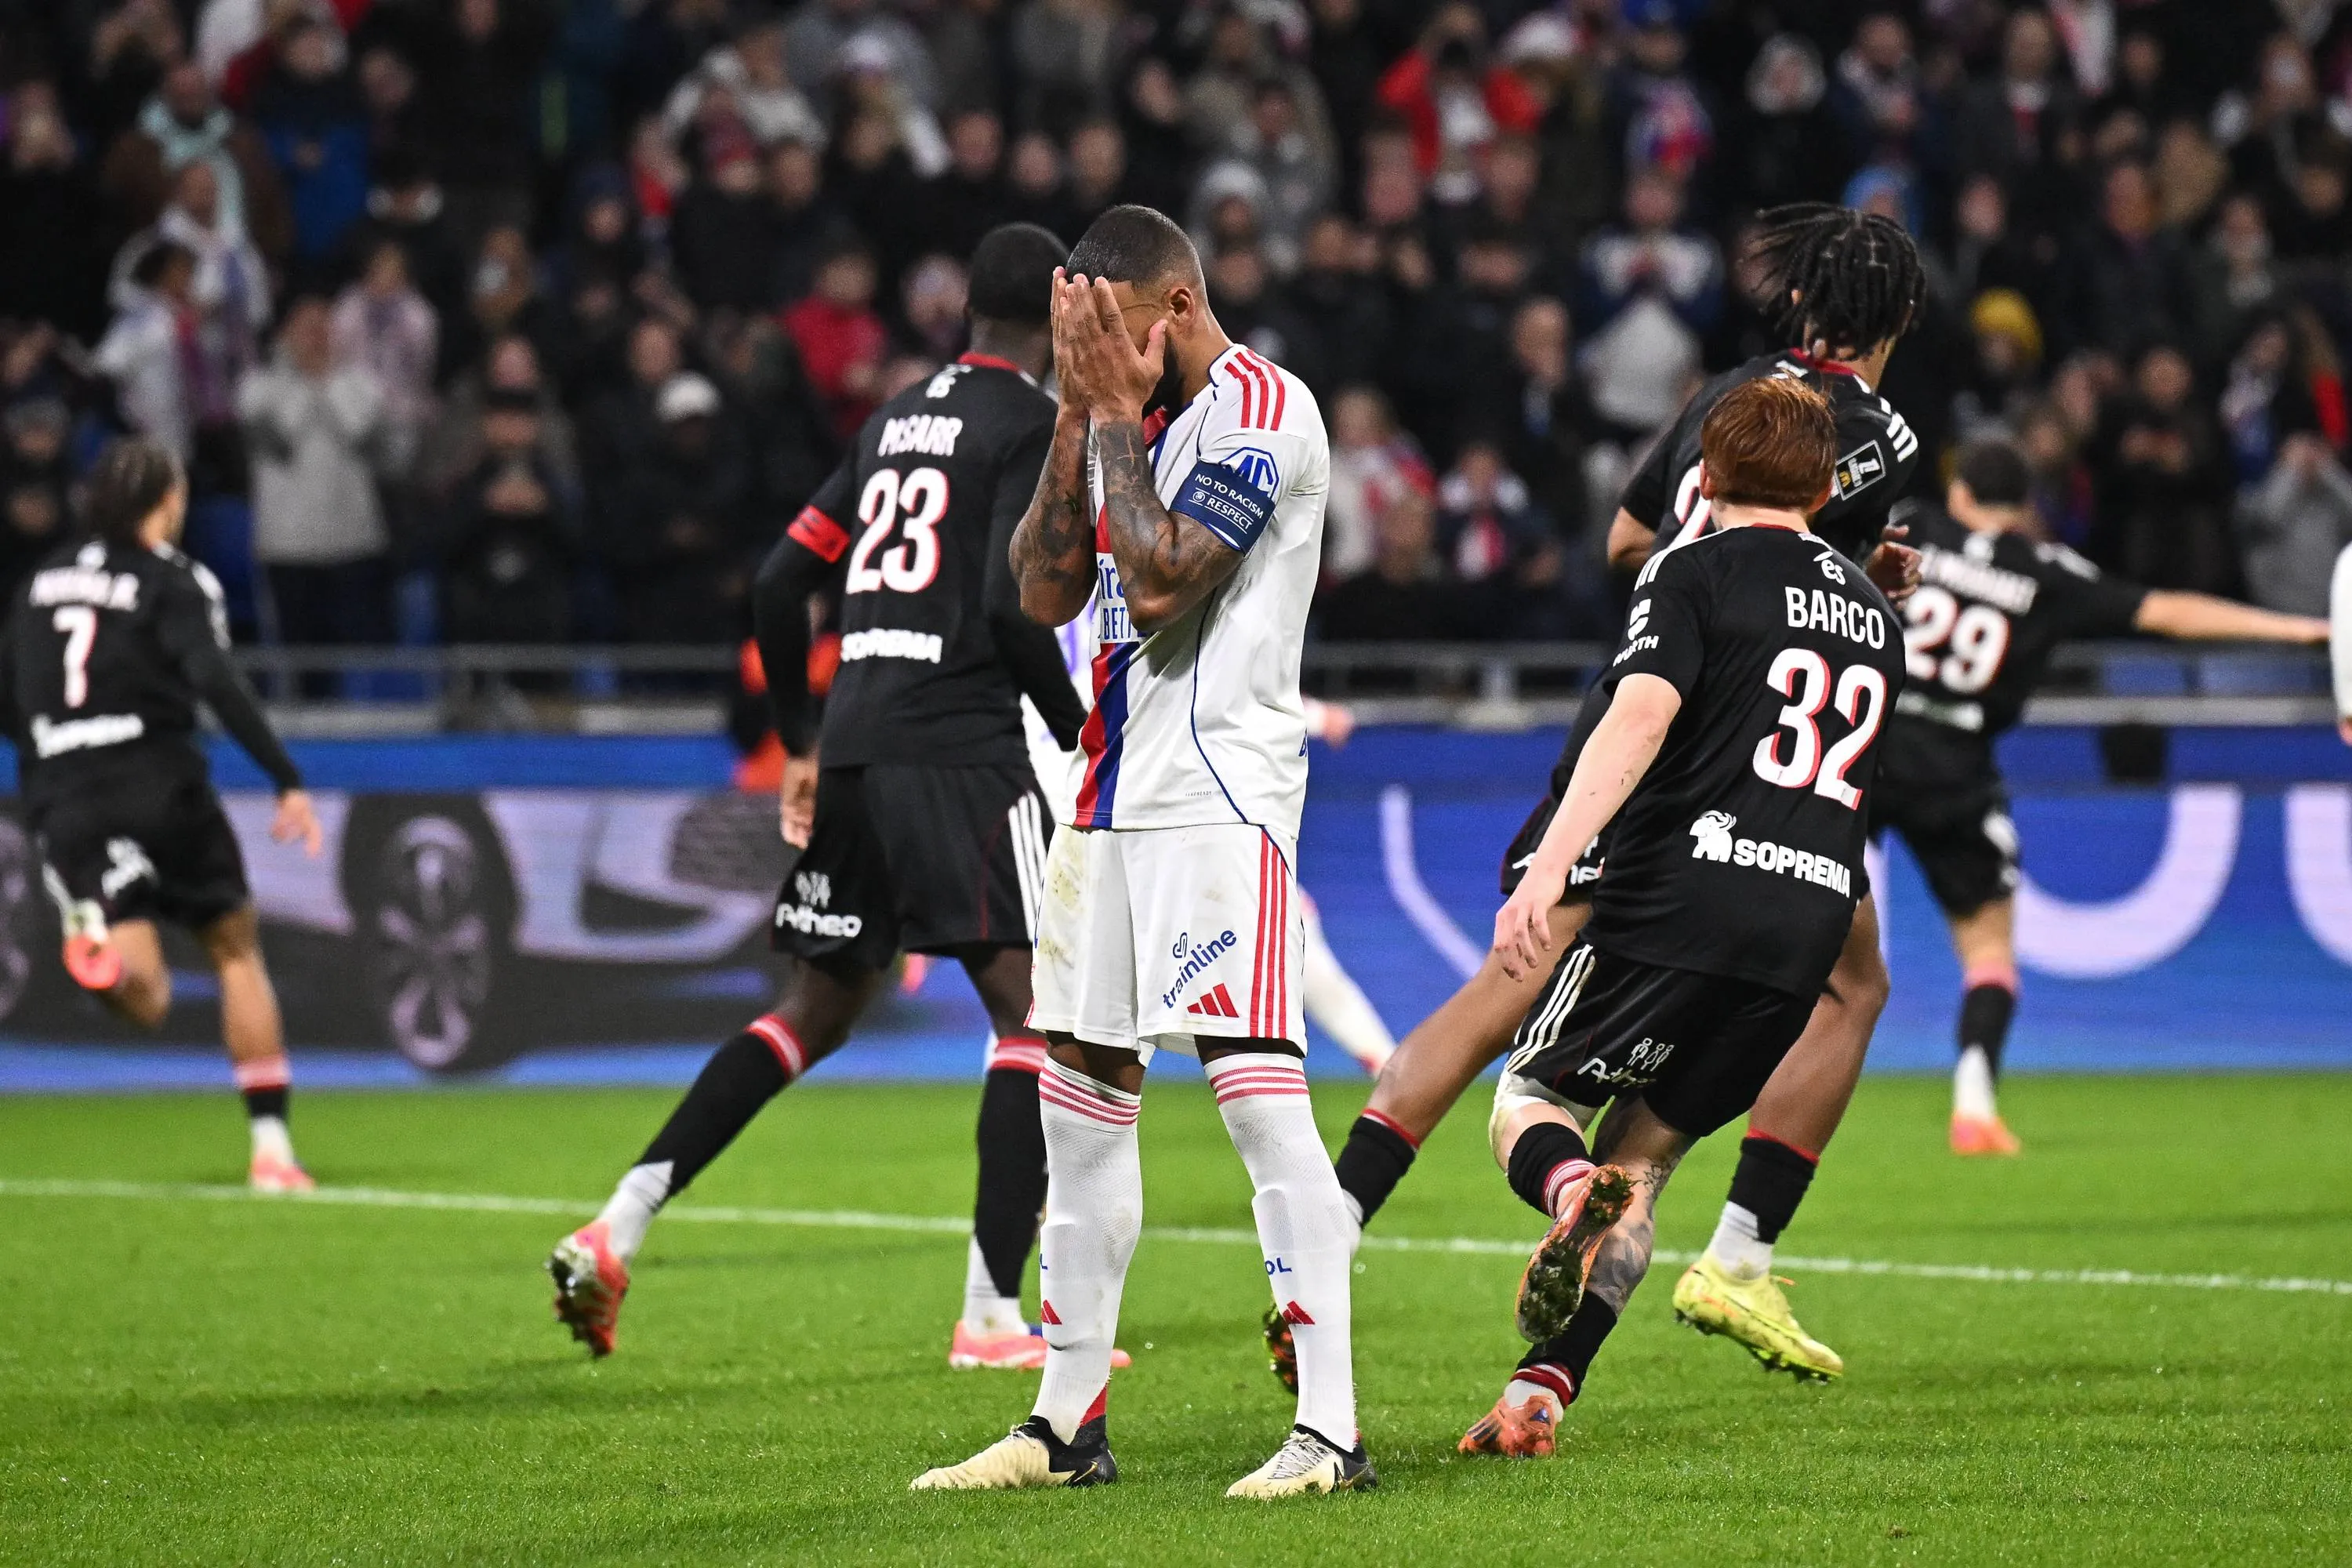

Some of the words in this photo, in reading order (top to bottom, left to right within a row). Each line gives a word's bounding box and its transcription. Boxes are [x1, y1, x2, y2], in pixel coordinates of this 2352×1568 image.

[845, 468, 949, 594] 23
[1194, 474, 1212, 486] NO
[1213, 481, 1228, 494] TO
[1228, 489, 1264, 519] RACISM
[1207, 497, 1253, 530] RESPECT
[1784, 586, 1886, 650] BARCO
[1904, 586, 2012, 695] 29
[52, 604, 97, 709] 7
[1752, 648, 1886, 811] 32
[1733, 838, 1851, 898] SOPREMA
[1162, 930, 1237, 1009] trainline
[1265, 1257, 1292, 1276] OL
